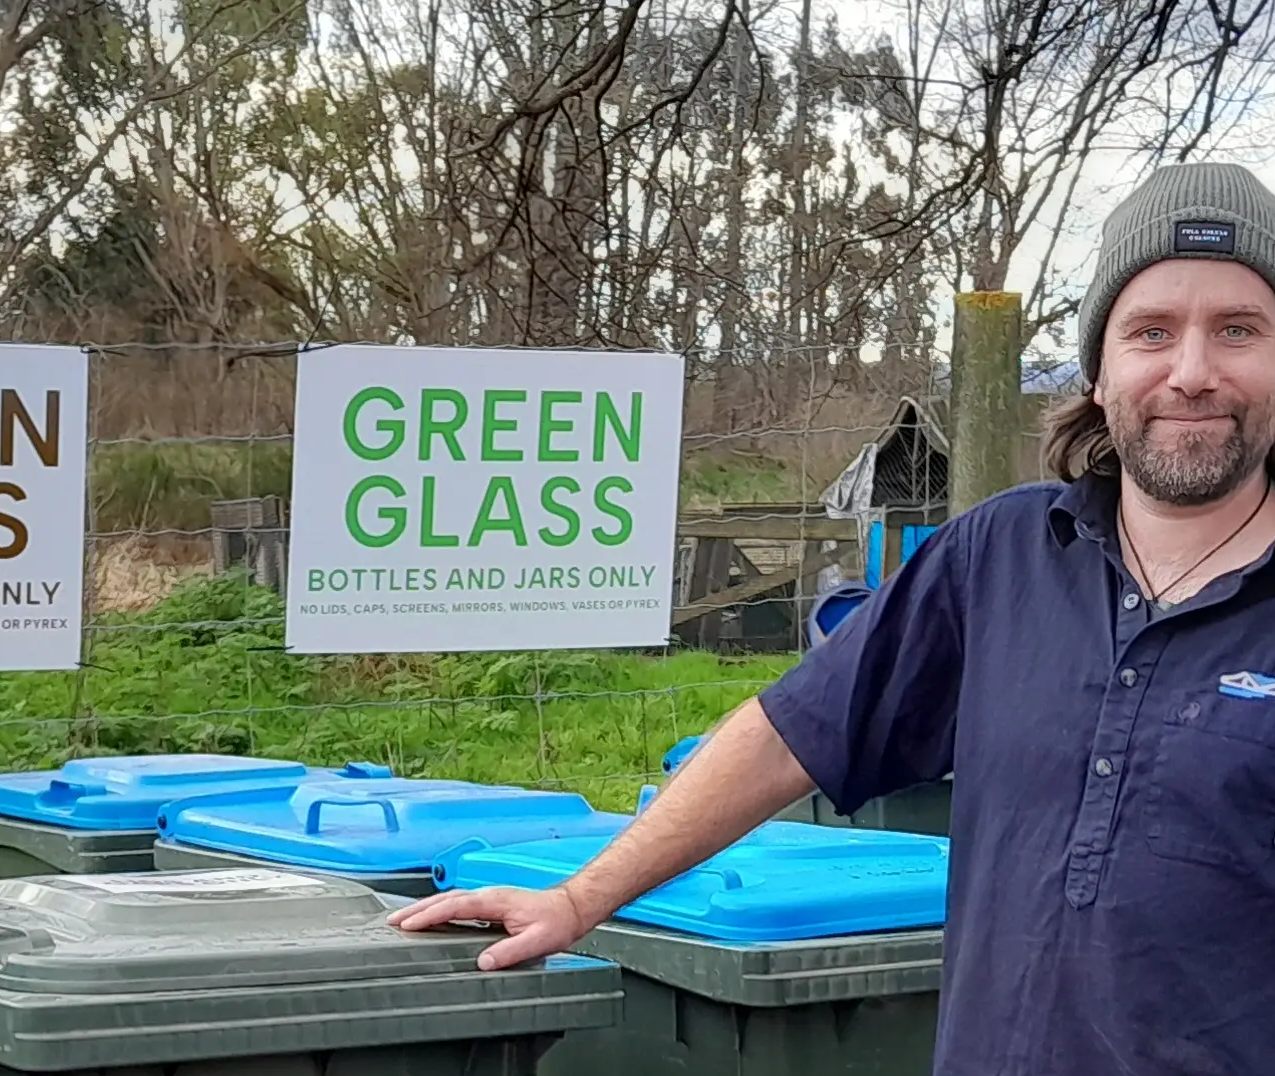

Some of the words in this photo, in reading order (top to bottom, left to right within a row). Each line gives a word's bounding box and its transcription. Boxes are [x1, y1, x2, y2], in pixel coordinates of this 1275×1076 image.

[343, 387, 642, 462] GREEN
[345, 475, 633, 548] GLASS
[308, 569, 437, 591] BOTTLES
[446, 568, 505, 590] AND
[514, 567, 580, 589] JARS
[589, 566, 655, 588] ONLY
[300, 605, 318, 614] NO
[321, 605, 350, 615] LIDS,
[354, 604, 389, 615] CAPS,
[393, 603, 448, 614] SCREENS,
[452, 603, 506, 612] MIRRORS,
[510, 602, 569, 612] WINDOWS,
[572, 601, 605, 609] VASES
[608, 600, 624, 609] OR
[626, 599, 660, 608] PYREX
[2, 619, 20, 629] OR
[24, 619, 67, 629] PYREX
